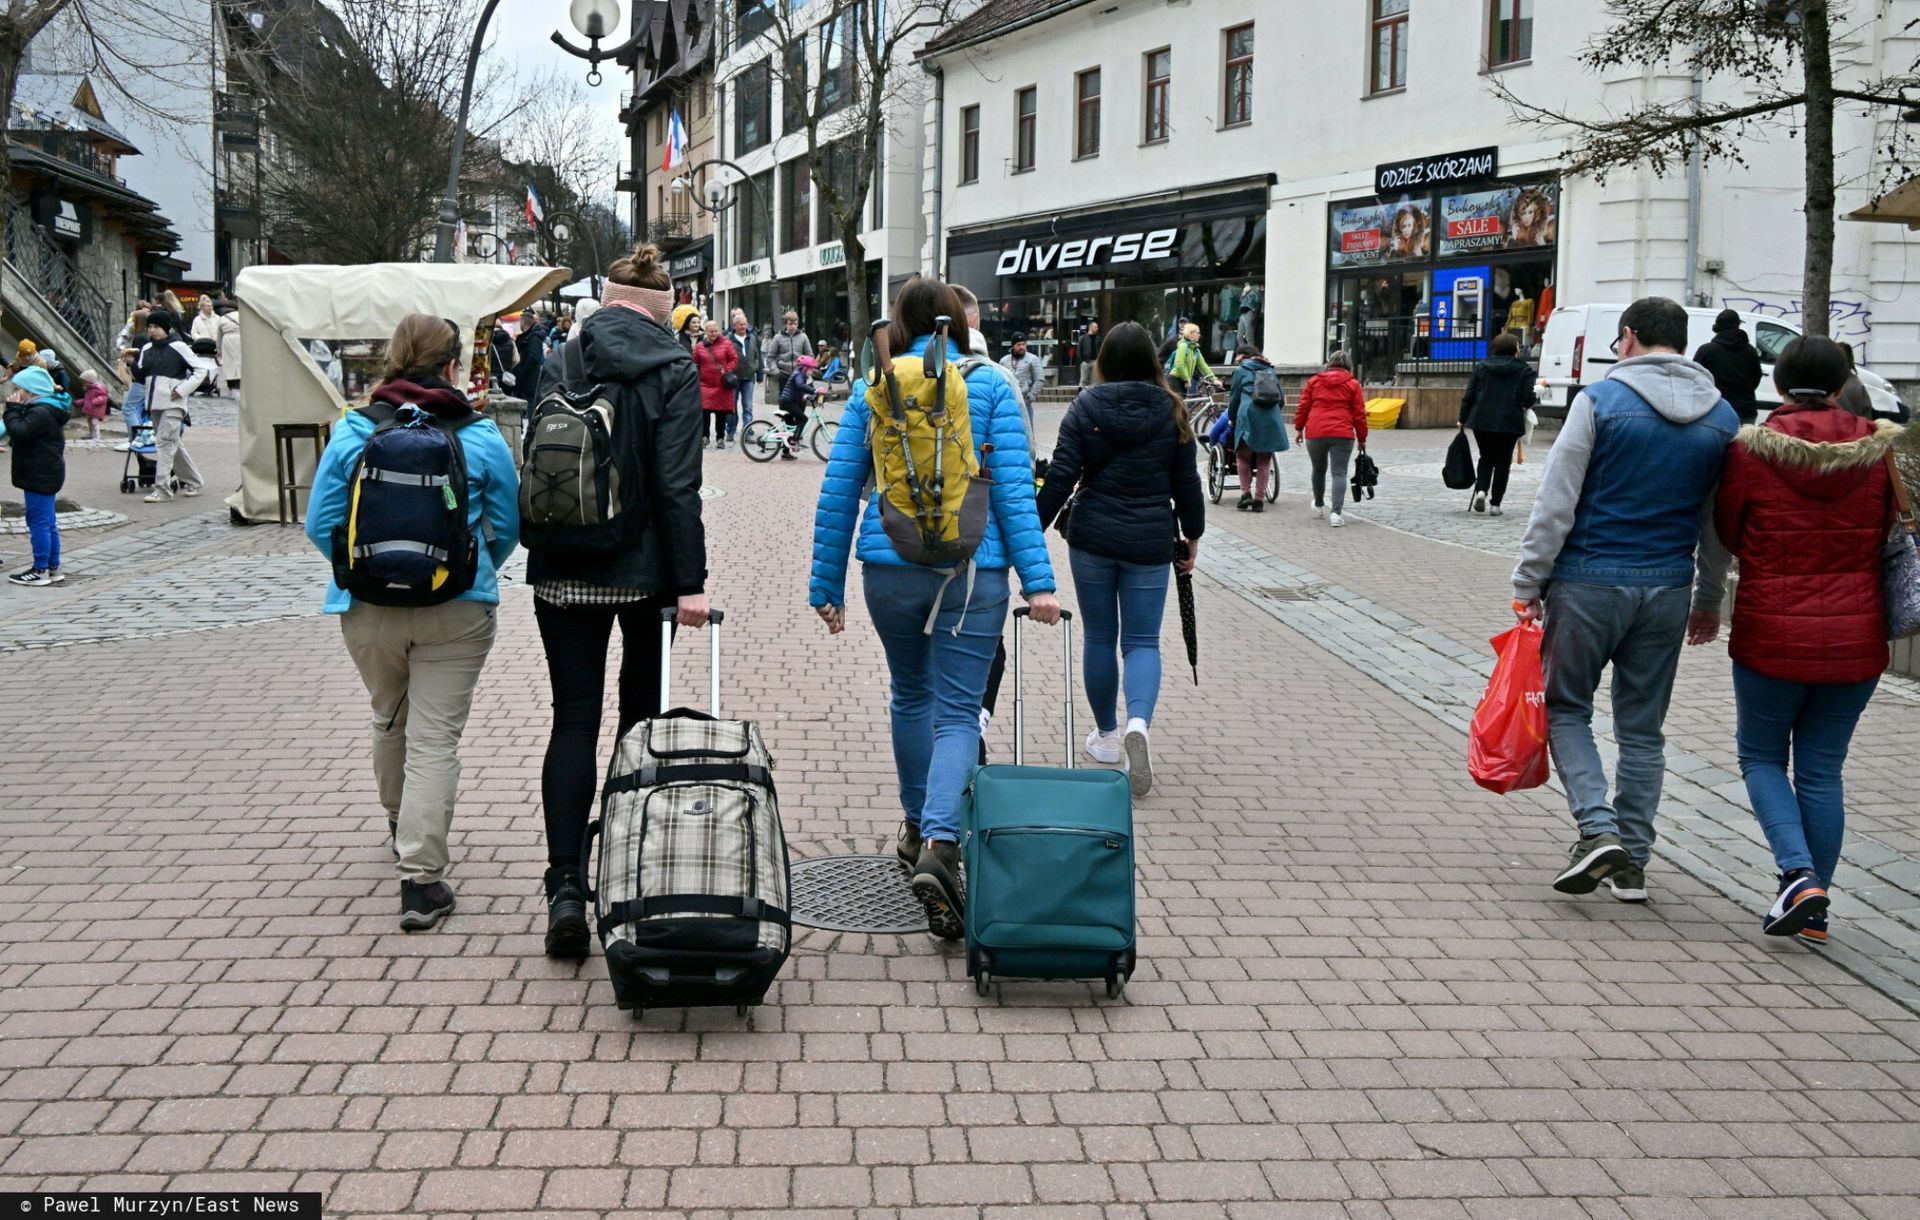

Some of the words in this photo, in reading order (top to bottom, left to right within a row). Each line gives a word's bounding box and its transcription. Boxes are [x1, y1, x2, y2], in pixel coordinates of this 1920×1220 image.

[1380, 162, 1424, 188] ODZIEŻ
[1426, 154, 1492, 182] SKÓRZANA
[1456, 218, 1489, 236] SALE
[1351, 231, 1370, 240] SKLEP
[1442, 235, 1504, 250] ZAPRASZAMY!
[995, 228, 1178, 276] diverse
[1340, 250, 1380, 261] PRODUCENT
